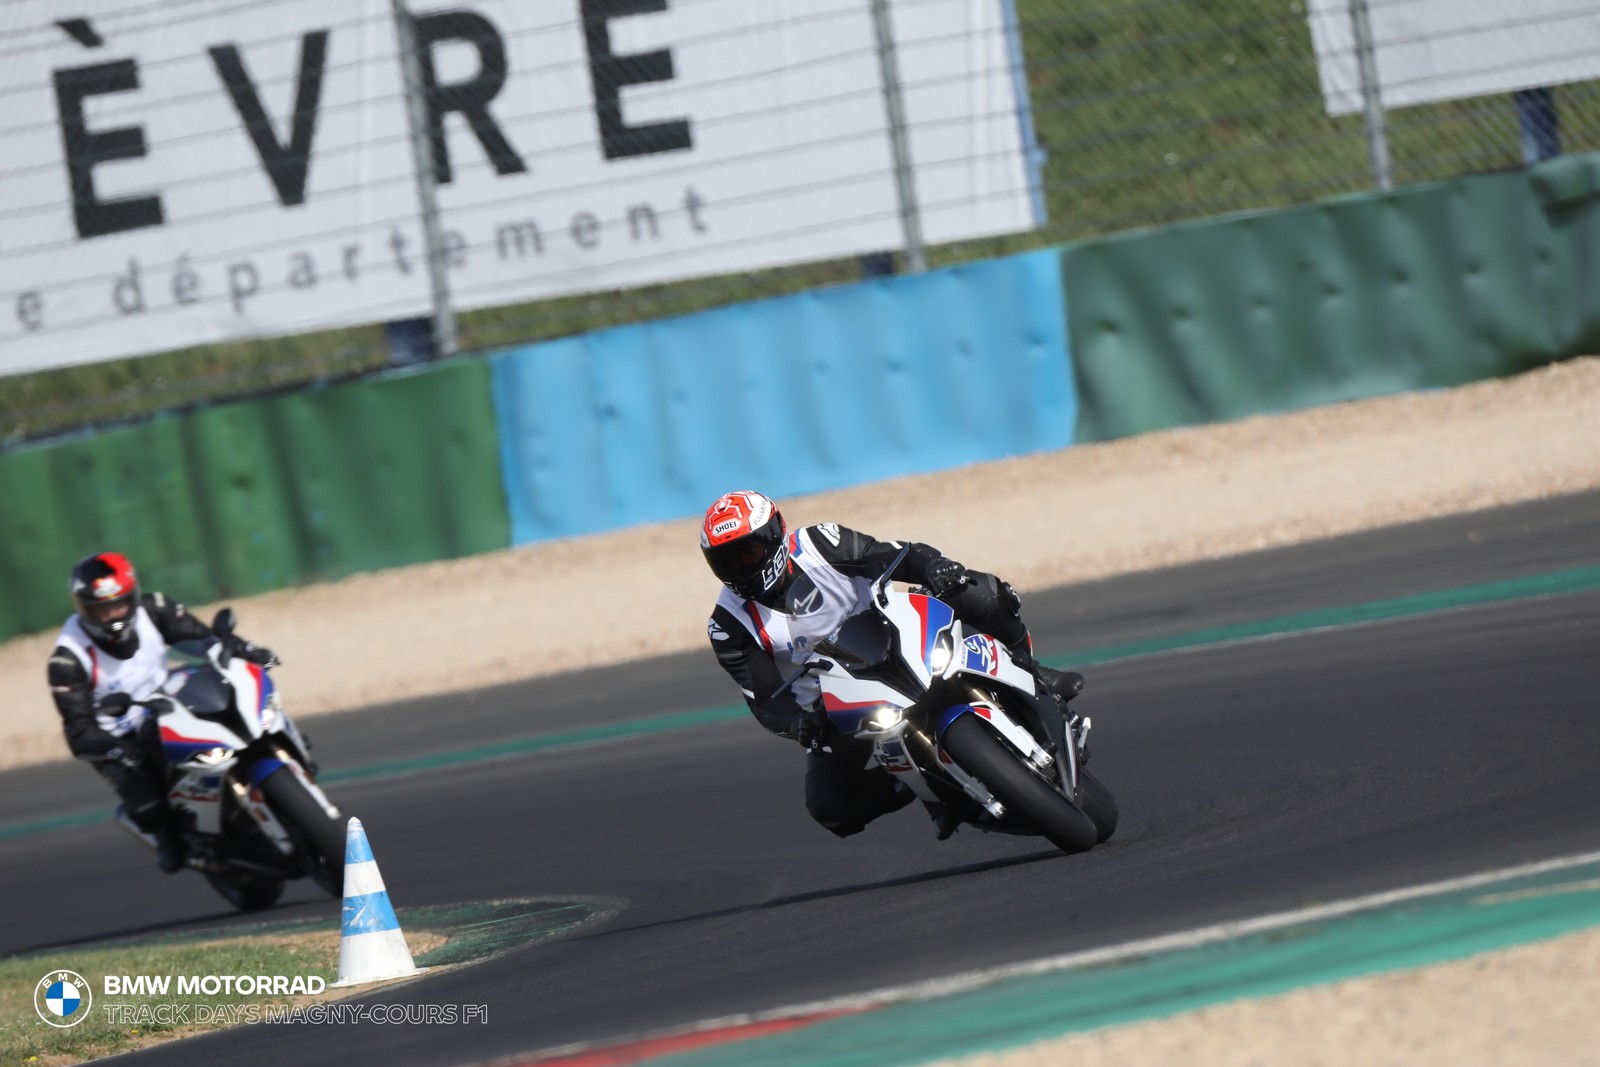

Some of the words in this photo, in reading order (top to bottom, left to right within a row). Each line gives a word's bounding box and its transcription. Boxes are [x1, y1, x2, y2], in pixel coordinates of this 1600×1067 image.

[52, 0, 693, 240] ÈVRE
[111, 185, 710, 316] département
[715, 520, 737, 534] SHOEI
